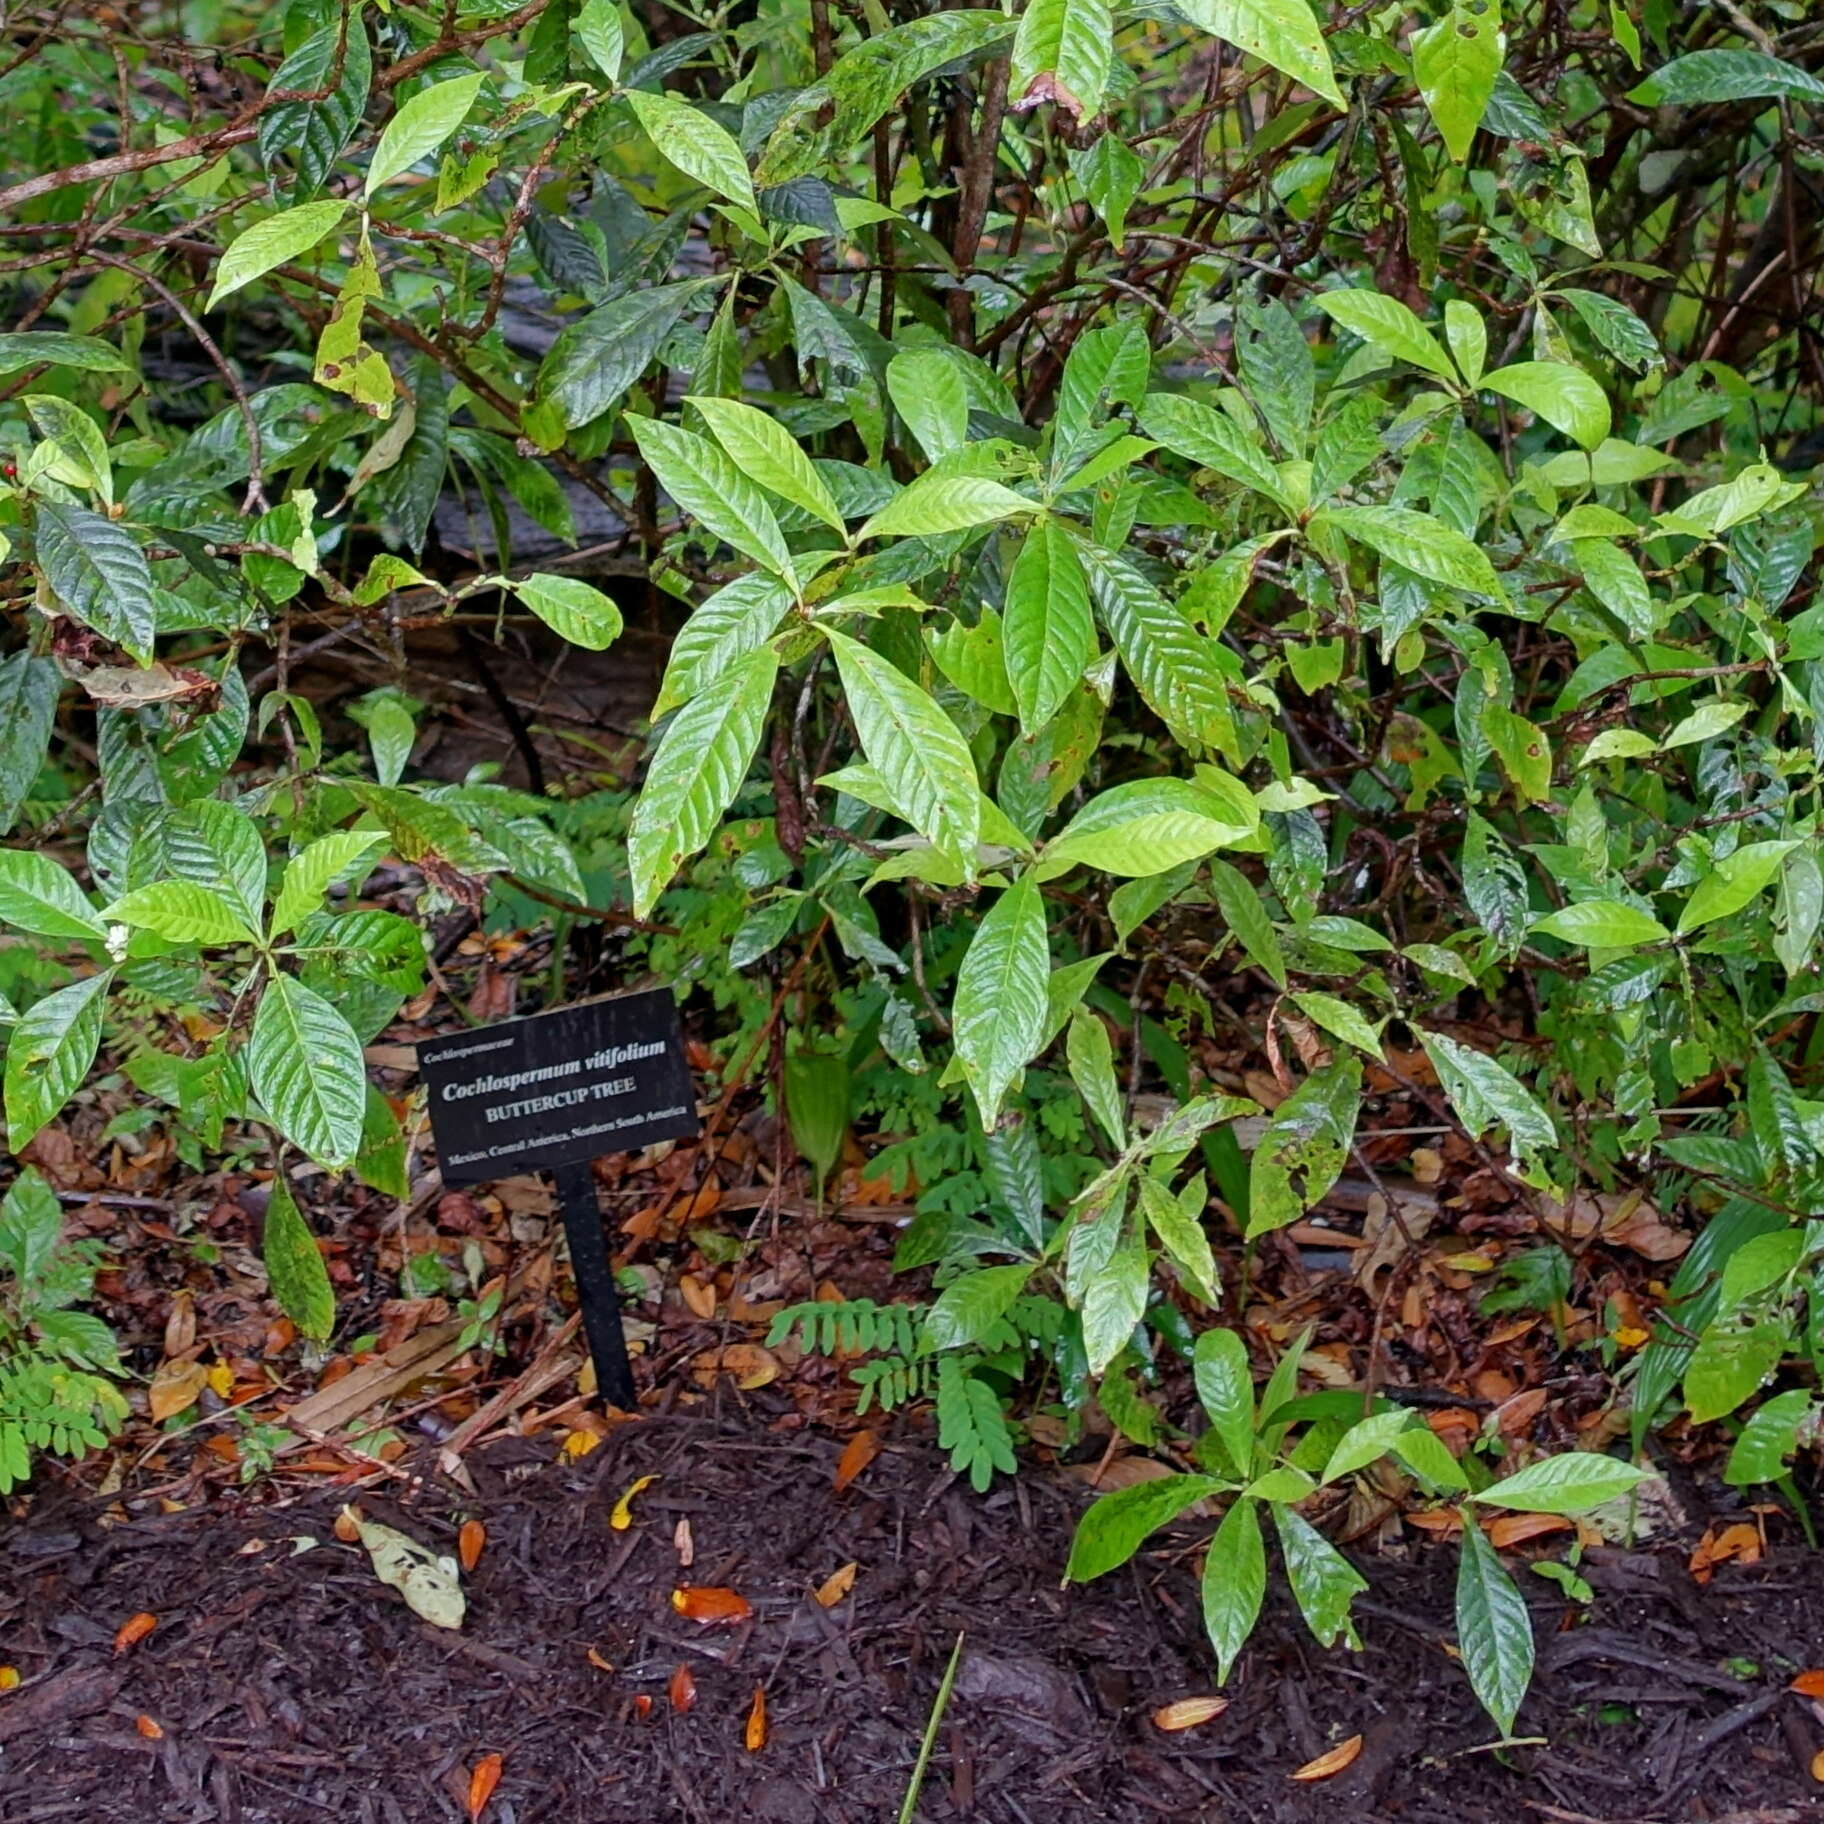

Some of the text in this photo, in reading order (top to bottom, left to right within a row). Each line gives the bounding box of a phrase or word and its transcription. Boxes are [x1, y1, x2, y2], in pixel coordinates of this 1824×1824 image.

[442, 1040, 666, 1102] Cochlospermum vitifolium
[485, 1076, 637, 1123] BUTTERCUP TREE
[616, 1113, 646, 1129] South
[646, 1105, 687, 1122] America
